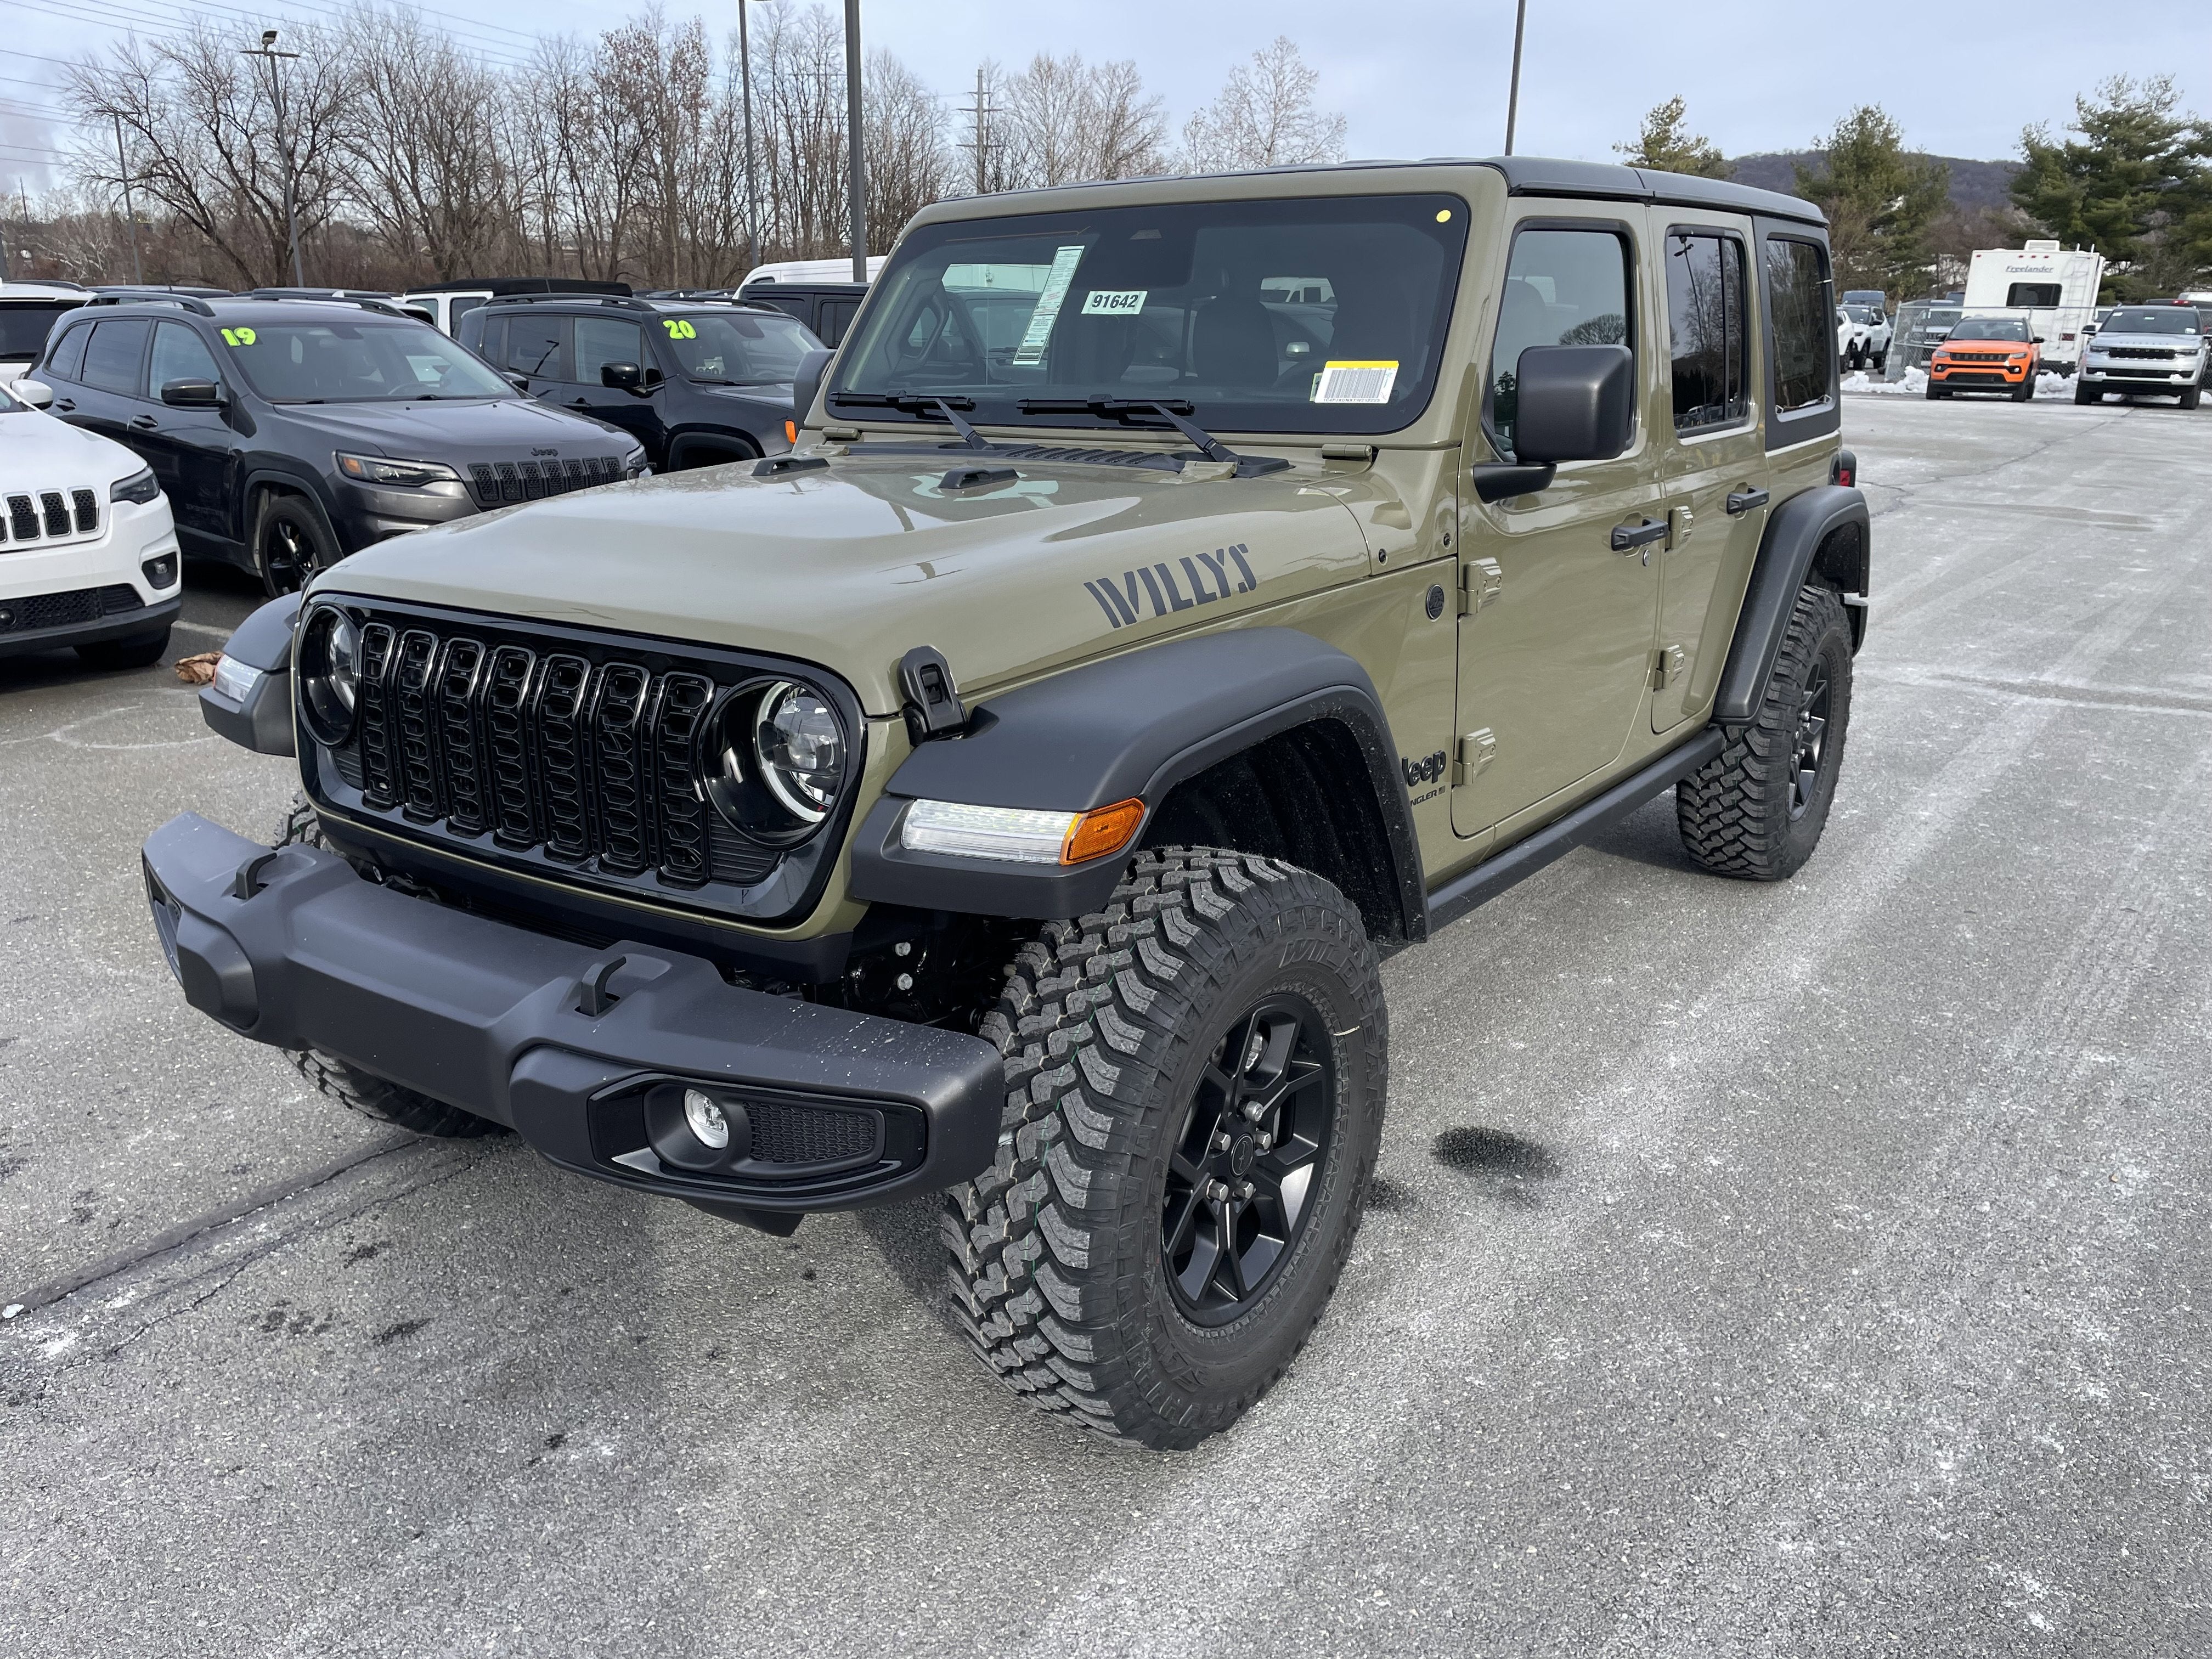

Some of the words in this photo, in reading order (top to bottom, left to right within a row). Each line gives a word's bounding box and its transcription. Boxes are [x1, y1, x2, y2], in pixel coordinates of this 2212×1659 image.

[1092, 295, 1138, 308] 91642
[221, 326, 256, 347] 19
[663, 320, 696, 339] 20
[531, 448, 558, 456] Jeep
[1083, 543, 1257, 629] WILLYS
[1410, 789, 1437, 806] NGLER
